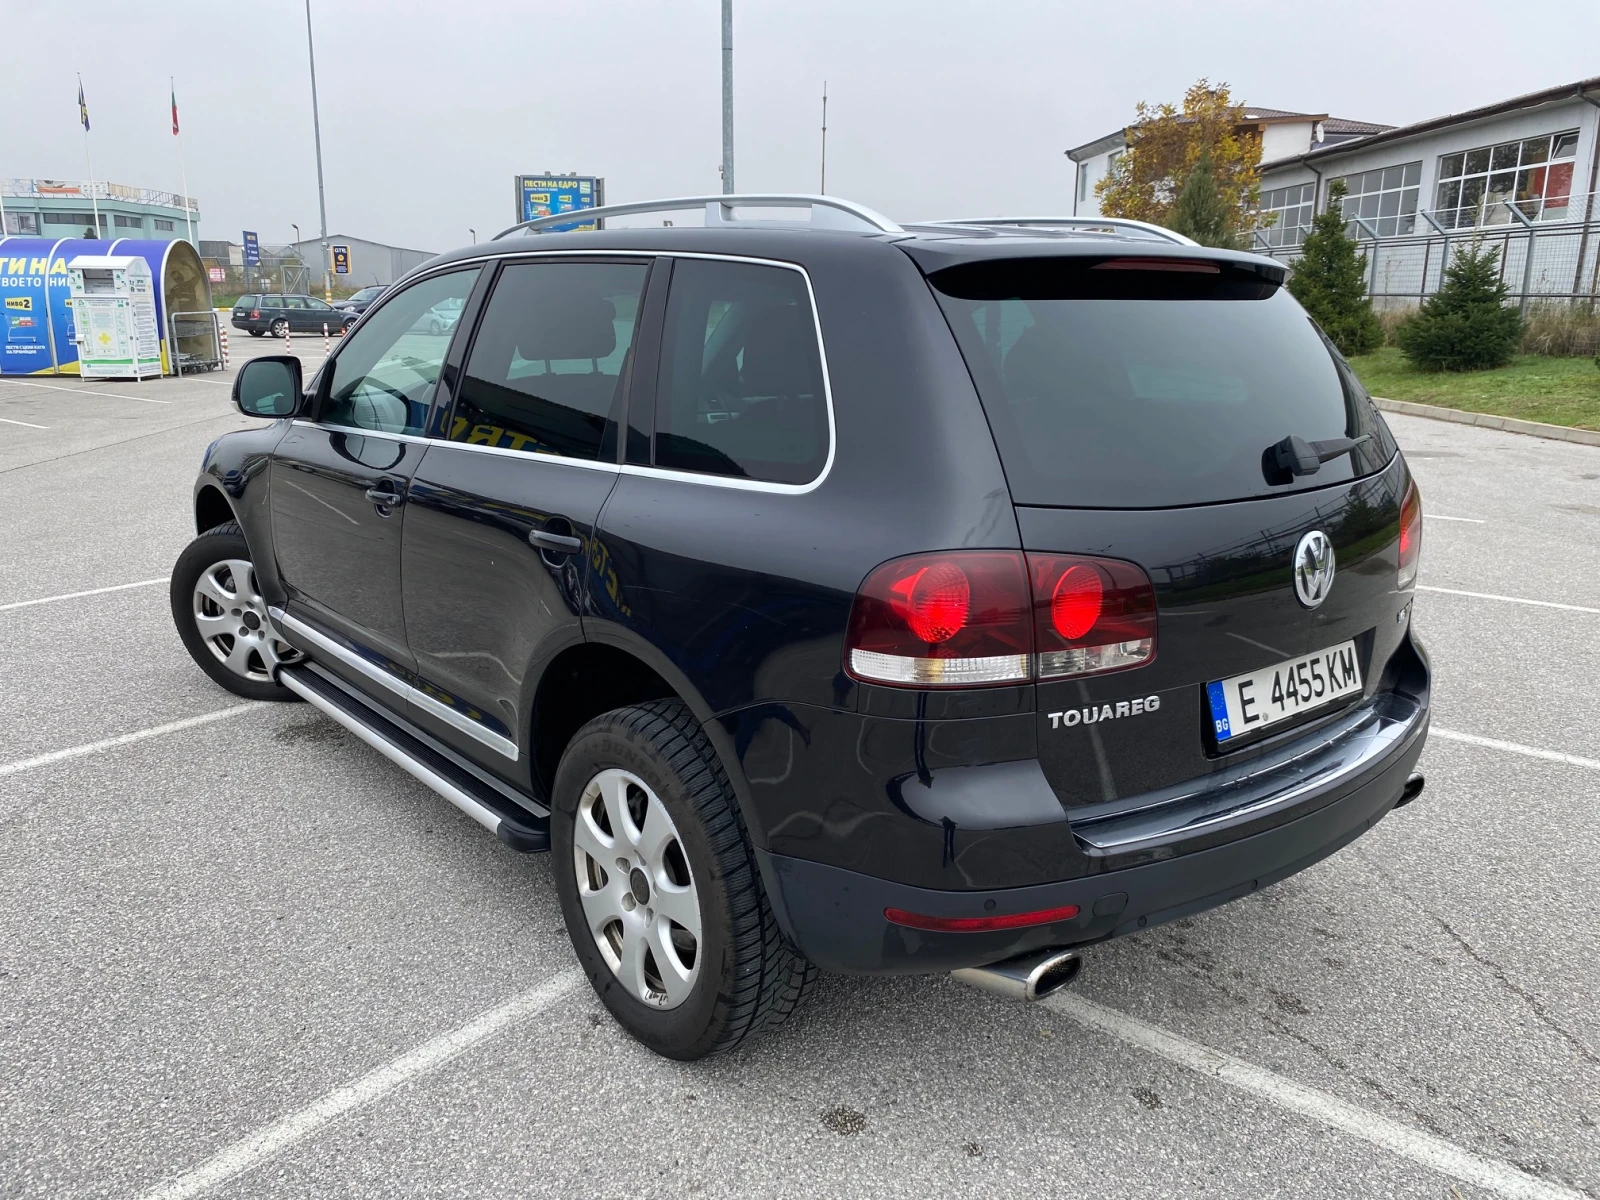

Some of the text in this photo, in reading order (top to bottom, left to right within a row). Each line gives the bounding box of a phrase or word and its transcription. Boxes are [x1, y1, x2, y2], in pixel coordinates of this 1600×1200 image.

[29, 257, 68, 275] НА
[0, 277, 42, 288] ВОЕТО
[23, 299, 30, 309] 2
[1238, 647, 1358, 725] E 4455 KM
[1048, 695, 1161, 729] TOUAREG
[1215, 718, 1230, 734] BG
